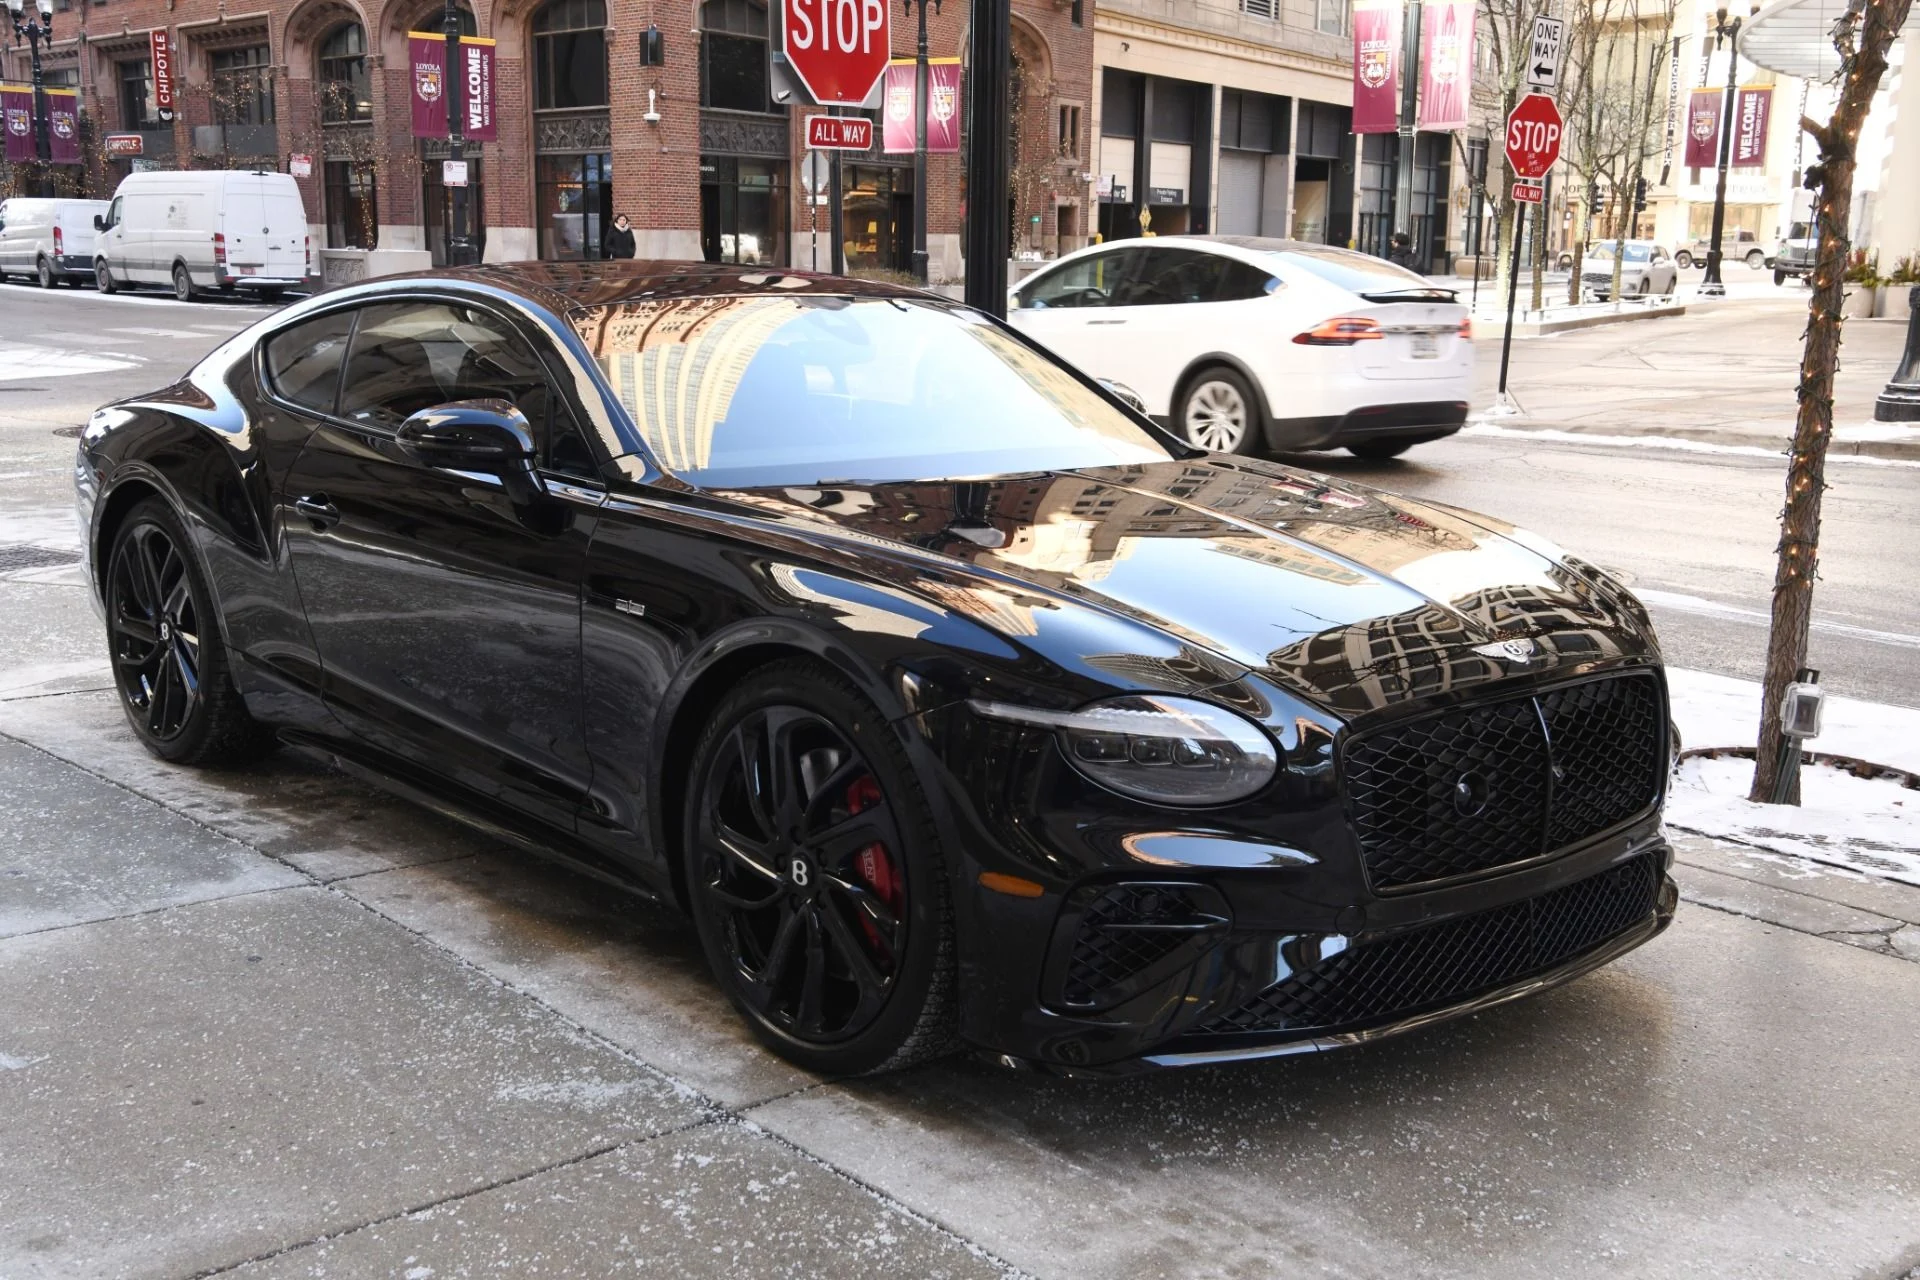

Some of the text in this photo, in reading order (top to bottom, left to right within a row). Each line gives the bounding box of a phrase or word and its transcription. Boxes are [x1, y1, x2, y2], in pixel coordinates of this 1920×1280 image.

[791, 0, 884, 54] STOP
[1537, 22, 1559, 41] ONE
[1361, 40, 1391, 50] LOYOLA
[1534, 41, 1558, 59] WAY
[155, 33, 170, 103] CHIPOTLE
[415, 63, 441, 71] LOYOLA
[468, 48, 482, 130] WELCOME
[814, 123, 866, 143] ALL WAY
[1509, 119, 1560, 153] STOP
[1739, 93, 1758, 160] WELCOME
[1515, 186, 1541, 200] ALL WAY
[161, 622, 169, 640] B
[792, 860, 808, 885] B
